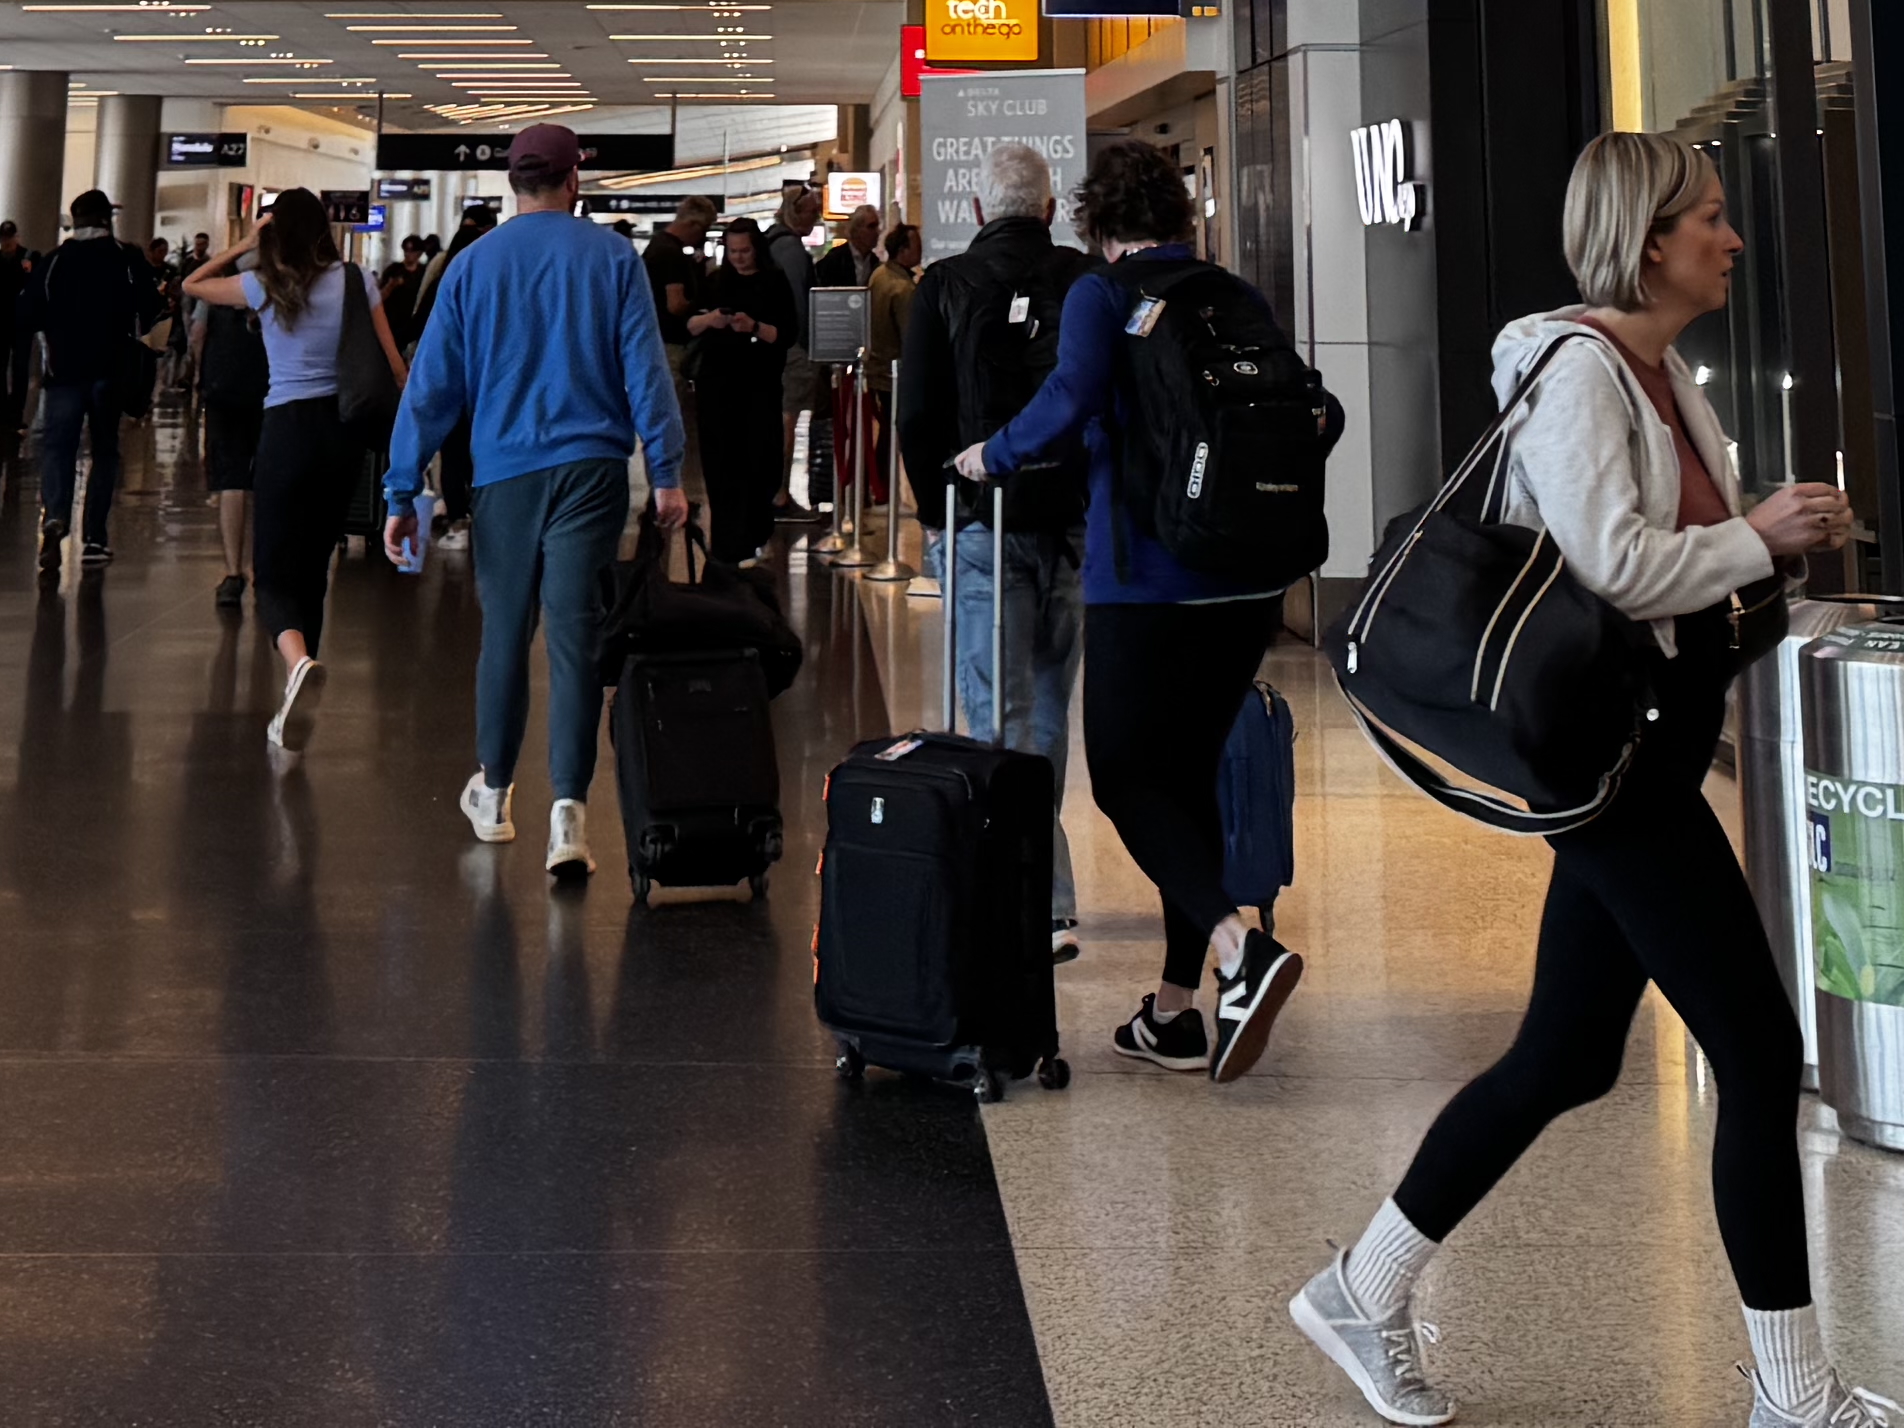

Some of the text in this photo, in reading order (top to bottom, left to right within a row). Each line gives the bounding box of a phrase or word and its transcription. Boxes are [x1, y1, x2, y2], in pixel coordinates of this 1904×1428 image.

[966, 87, 1001, 97] DELTA
[966, 98, 1048, 117] SKY CLUB
[932, 136, 995, 161] GREAT
[943, 167, 979, 193] ARE
